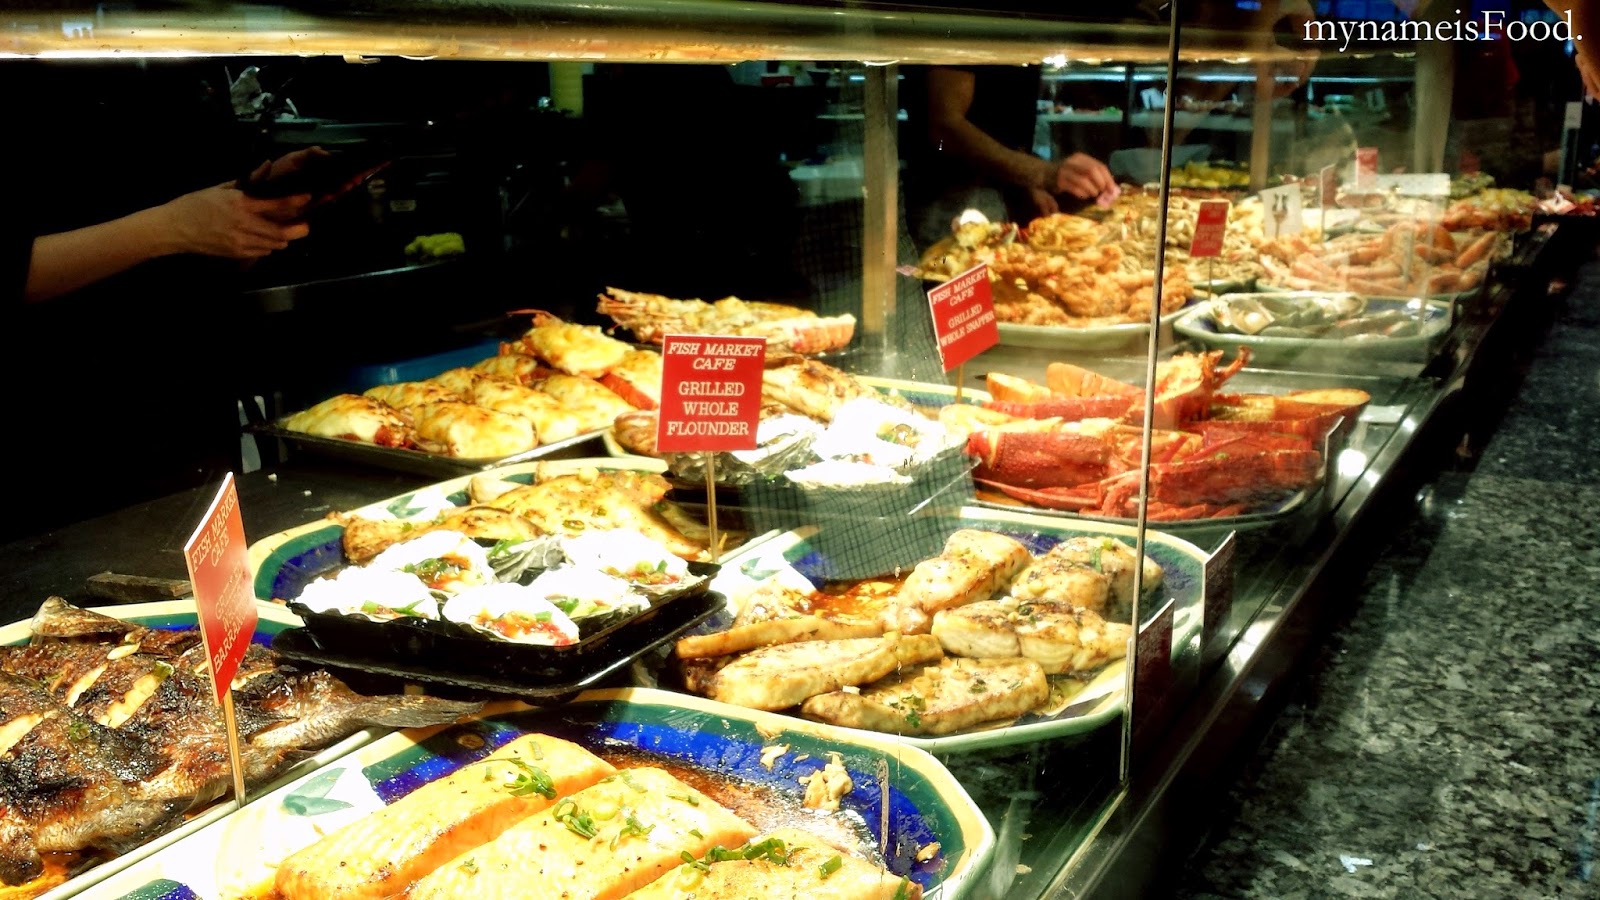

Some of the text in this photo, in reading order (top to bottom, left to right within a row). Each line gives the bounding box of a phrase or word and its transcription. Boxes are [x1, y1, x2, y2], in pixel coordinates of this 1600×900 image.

[932, 267, 987, 305] FISH MARKET
[949, 286, 974, 307] CAFE
[948, 303, 983, 329] GRILLED
[940, 326, 966, 347] WHOLE
[667, 342, 762, 357] FISH MARKET
[692, 358, 736, 371] CAFE
[678, 381, 745, 396] GRILLED
[683, 402, 739, 416] WHOLE
[667, 421, 749, 436] FLOUNDER
[191, 531, 212, 573] FISH
[211, 526, 230, 567] CAFE
